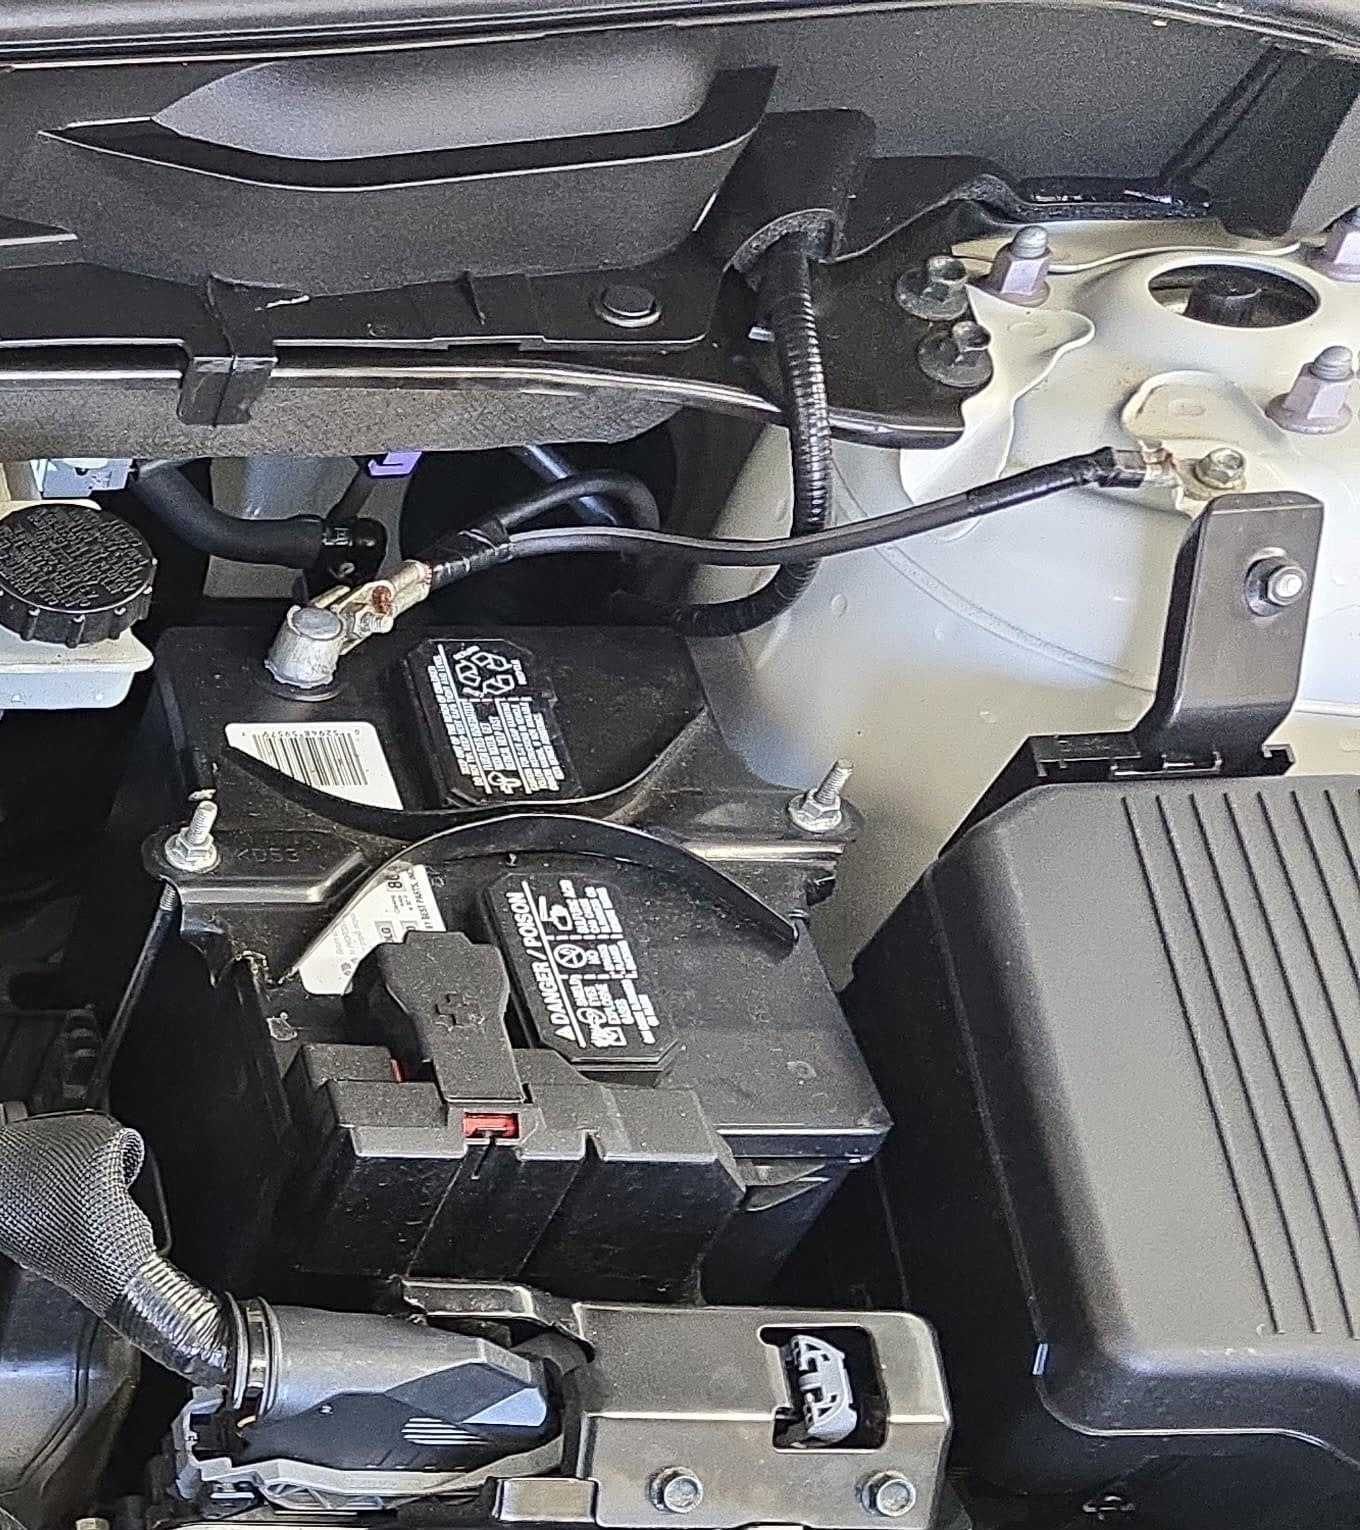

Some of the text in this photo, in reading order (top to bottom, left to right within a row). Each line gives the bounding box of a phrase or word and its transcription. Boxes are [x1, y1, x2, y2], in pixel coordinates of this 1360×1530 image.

[417, 903, 430, 920] BEST
[503, 891, 543, 947] POISON
[528, 960, 571, 1024] DANGER
